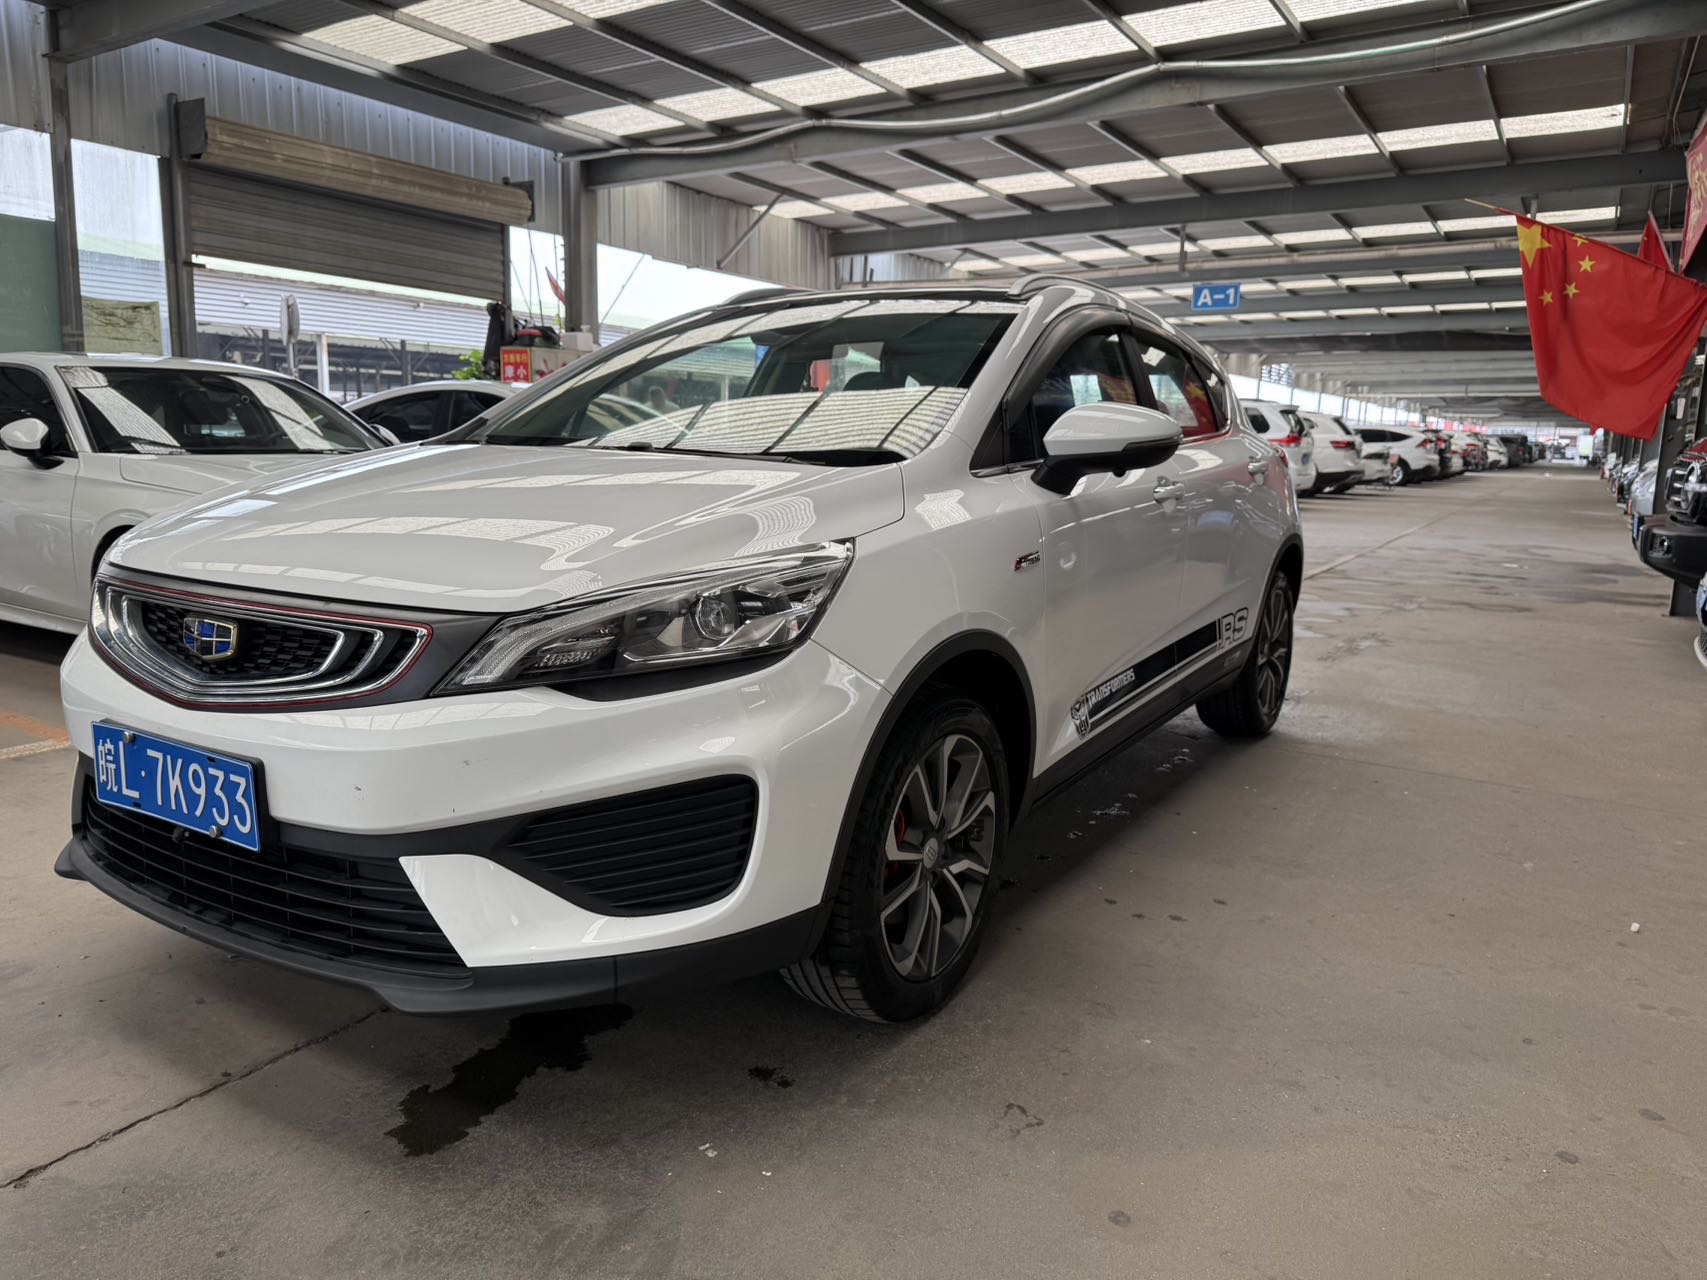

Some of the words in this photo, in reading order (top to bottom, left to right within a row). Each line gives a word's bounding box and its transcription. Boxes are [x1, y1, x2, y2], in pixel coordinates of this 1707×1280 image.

[1197, 288, 1235, 306] A-1
[1221, 607, 1248, 649] RS
[1087, 669, 1136, 706] TRANSFORMERS
